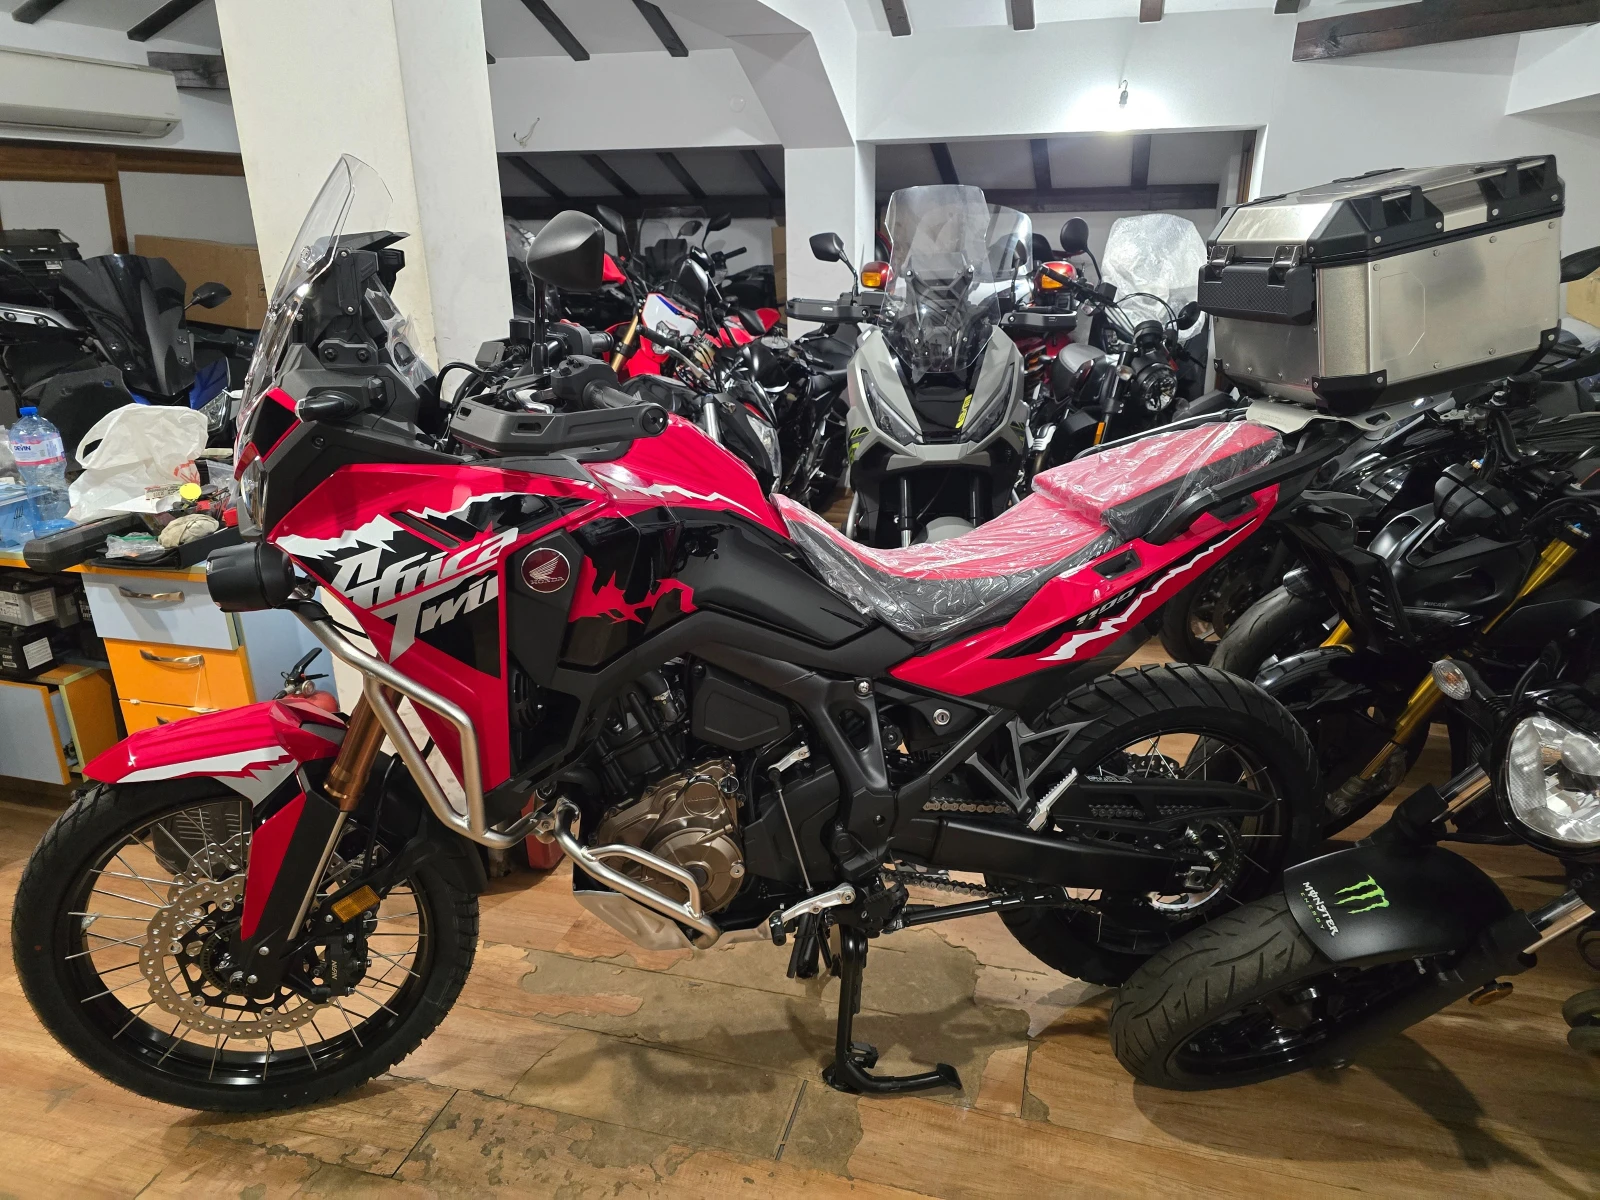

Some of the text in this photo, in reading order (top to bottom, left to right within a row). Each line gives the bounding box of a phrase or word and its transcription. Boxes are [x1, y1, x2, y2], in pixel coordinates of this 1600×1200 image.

[332, 527, 519, 609] Africa
[1076, 587, 1137, 627] 1100
[1300, 892, 1325, 930] ENERGY
[1302, 881, 1339, 937] MONSTER
